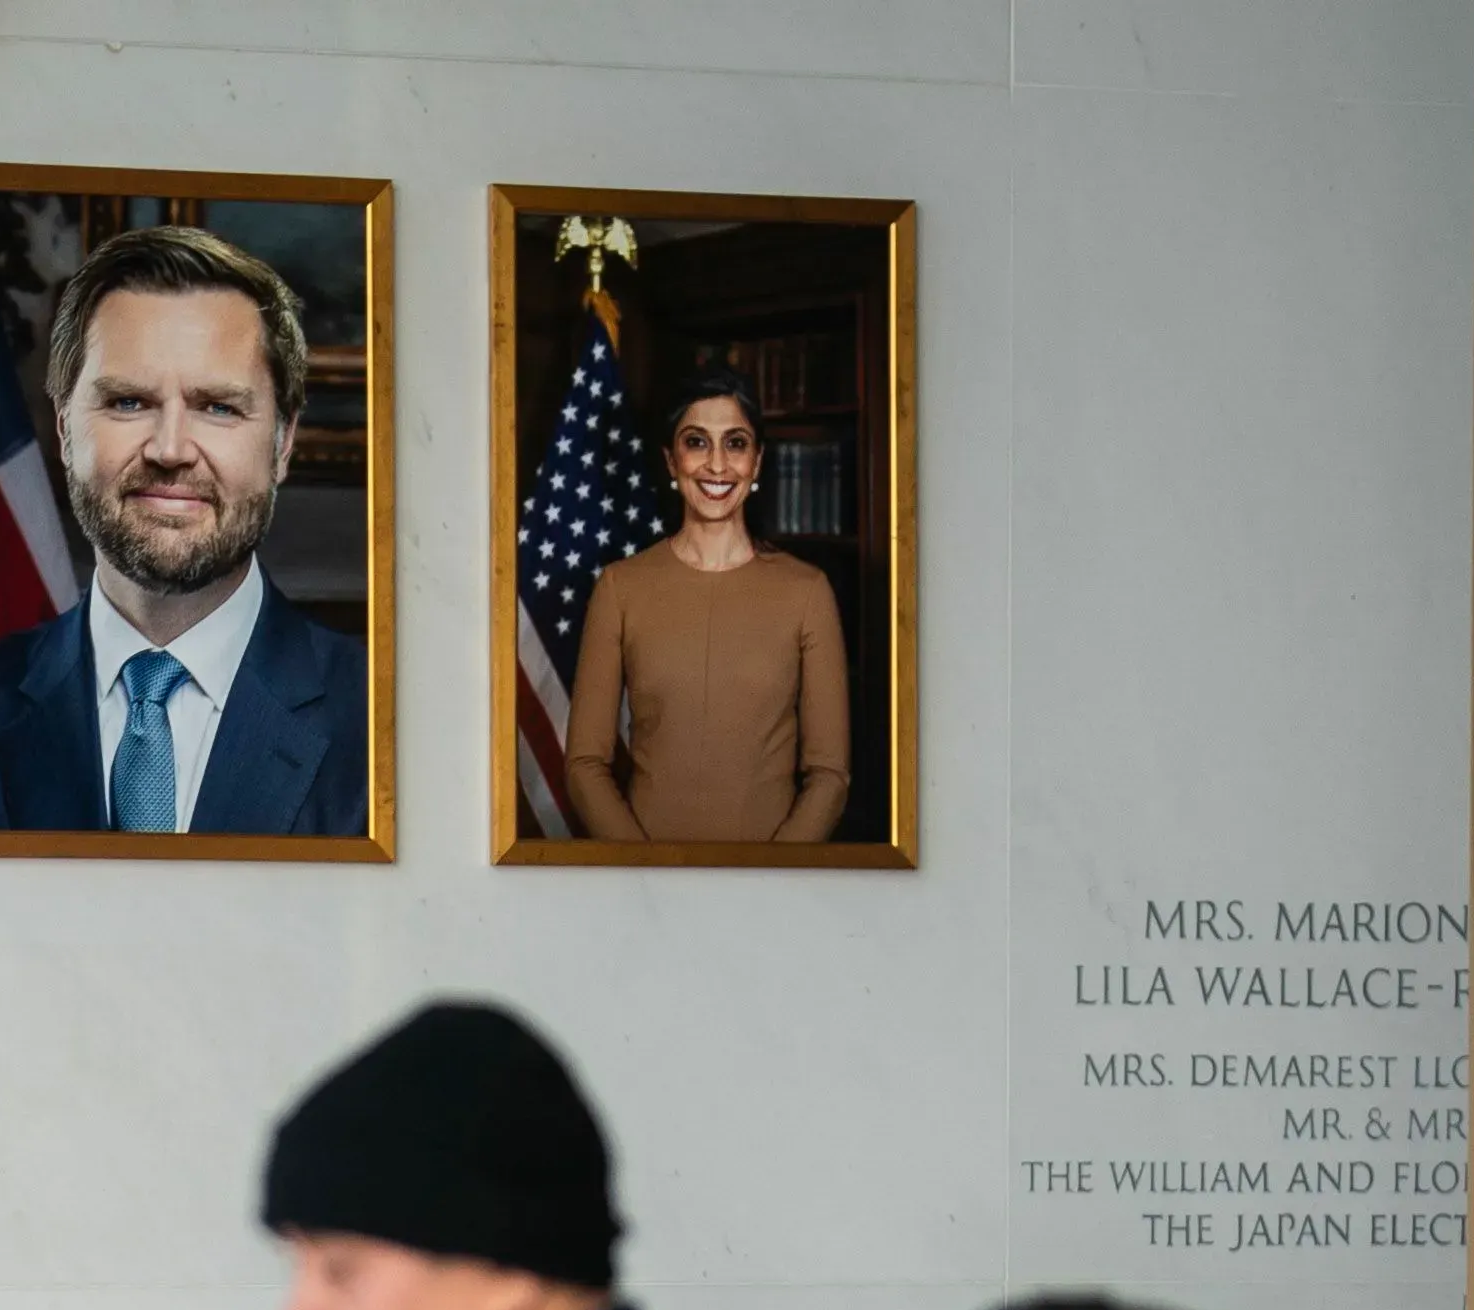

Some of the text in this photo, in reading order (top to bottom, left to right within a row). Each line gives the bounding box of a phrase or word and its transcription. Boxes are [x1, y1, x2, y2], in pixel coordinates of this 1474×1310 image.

[1144, 900, 1254, 941] MRS.
[1274, 903, 1467, 943] MARION
[1075, 966, 1176, 1005] LILA
[1084, 1054, 1174, 1086] MRS.
[1190, 1056, 1397, 1088] DEMAREST
[1283, 1109, 1353, 1140] MR.
[1365, 1109, 1391, 1140] &
[1021, 1161, 1094, 1192] THE
[1109, 1161, 1269, 1194] WILLIAM
[1286, 1162, 1373, 1194] AND
[1394, 1163, 1467, 1195] FLO
[1143, 1214, 1214, 1246] THE
[1229, 1214, 1351, 1251] JAPAN
